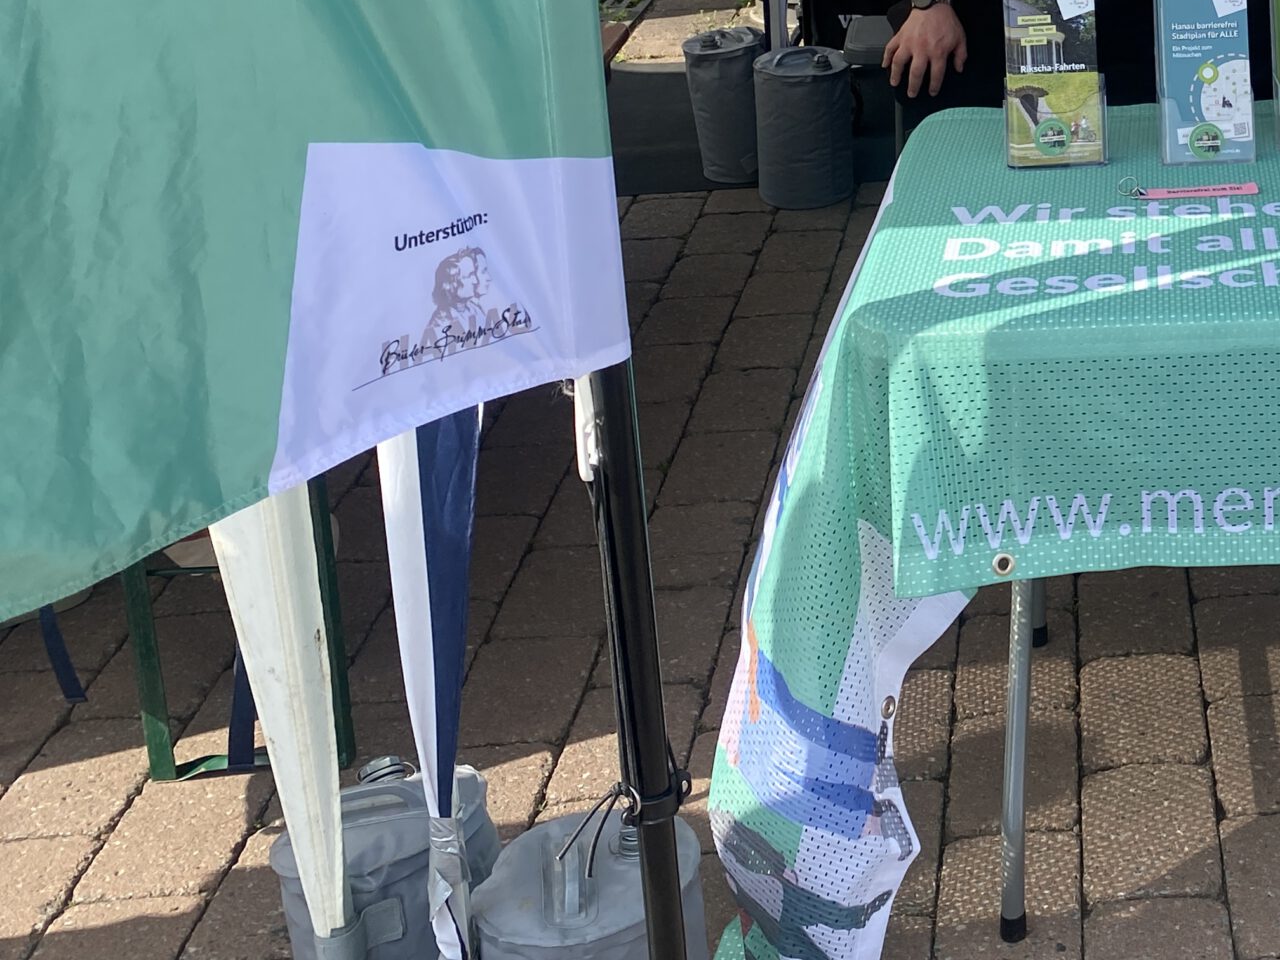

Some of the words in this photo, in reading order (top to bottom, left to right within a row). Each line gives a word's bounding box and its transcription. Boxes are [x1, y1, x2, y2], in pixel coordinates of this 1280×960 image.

[1171, 22, 1195, 30] Hanau
[1196, 21, 1238, 29] barrierefrei
[1171, 31, 1206, 40] Stadtplan
[1220, 30, 1239, 38] ALLE
[1020, 63, 1086, 74] Rikscha-Fahrten
[950, 202, 1086, 227] Wir
[943, 231, 1172, 261] Damit
